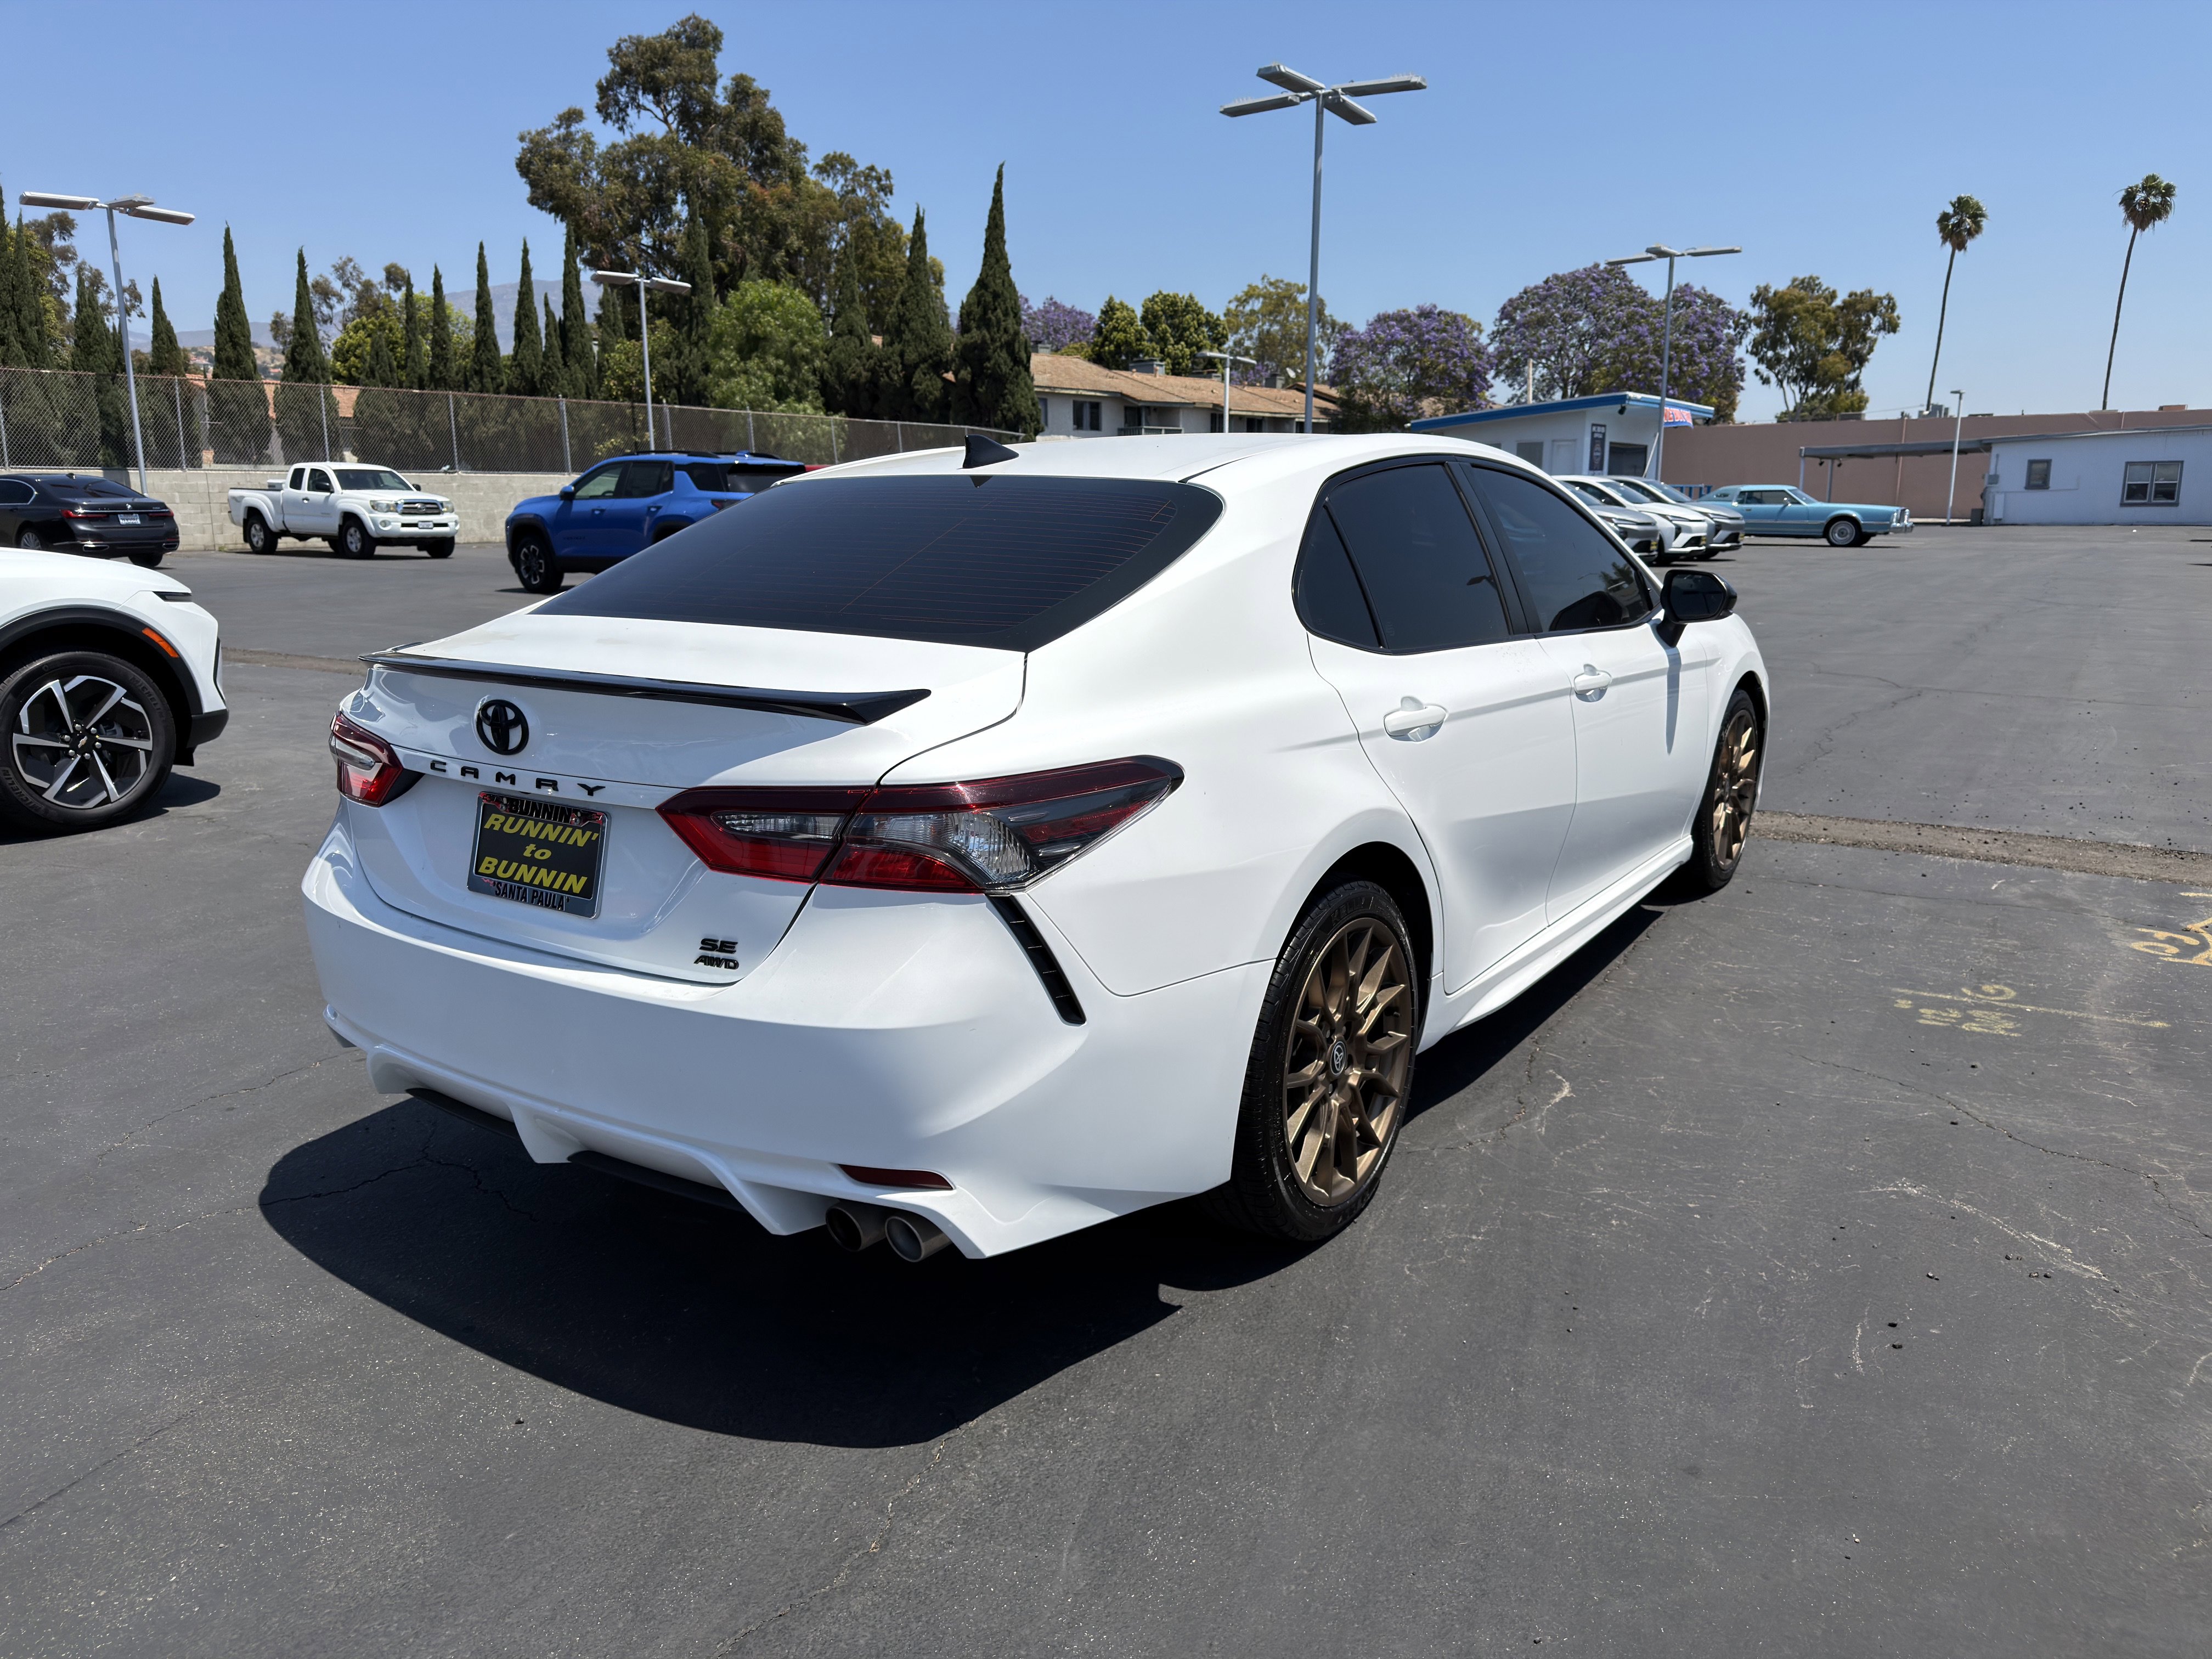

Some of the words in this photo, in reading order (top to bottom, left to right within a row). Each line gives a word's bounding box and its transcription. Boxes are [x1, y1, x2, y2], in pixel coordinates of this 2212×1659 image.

[1, 769, 42, 813] MICHELIN
[431, 760, 606, 797] CAMRY
[484, 813, 600, 847] RUNNIN'
[523, 843, 552, 860] to
[478, 856, 588, 894] BUNNIN
[693, 955, 739, 970] AWD
[699, 938, 738, 954] SE
